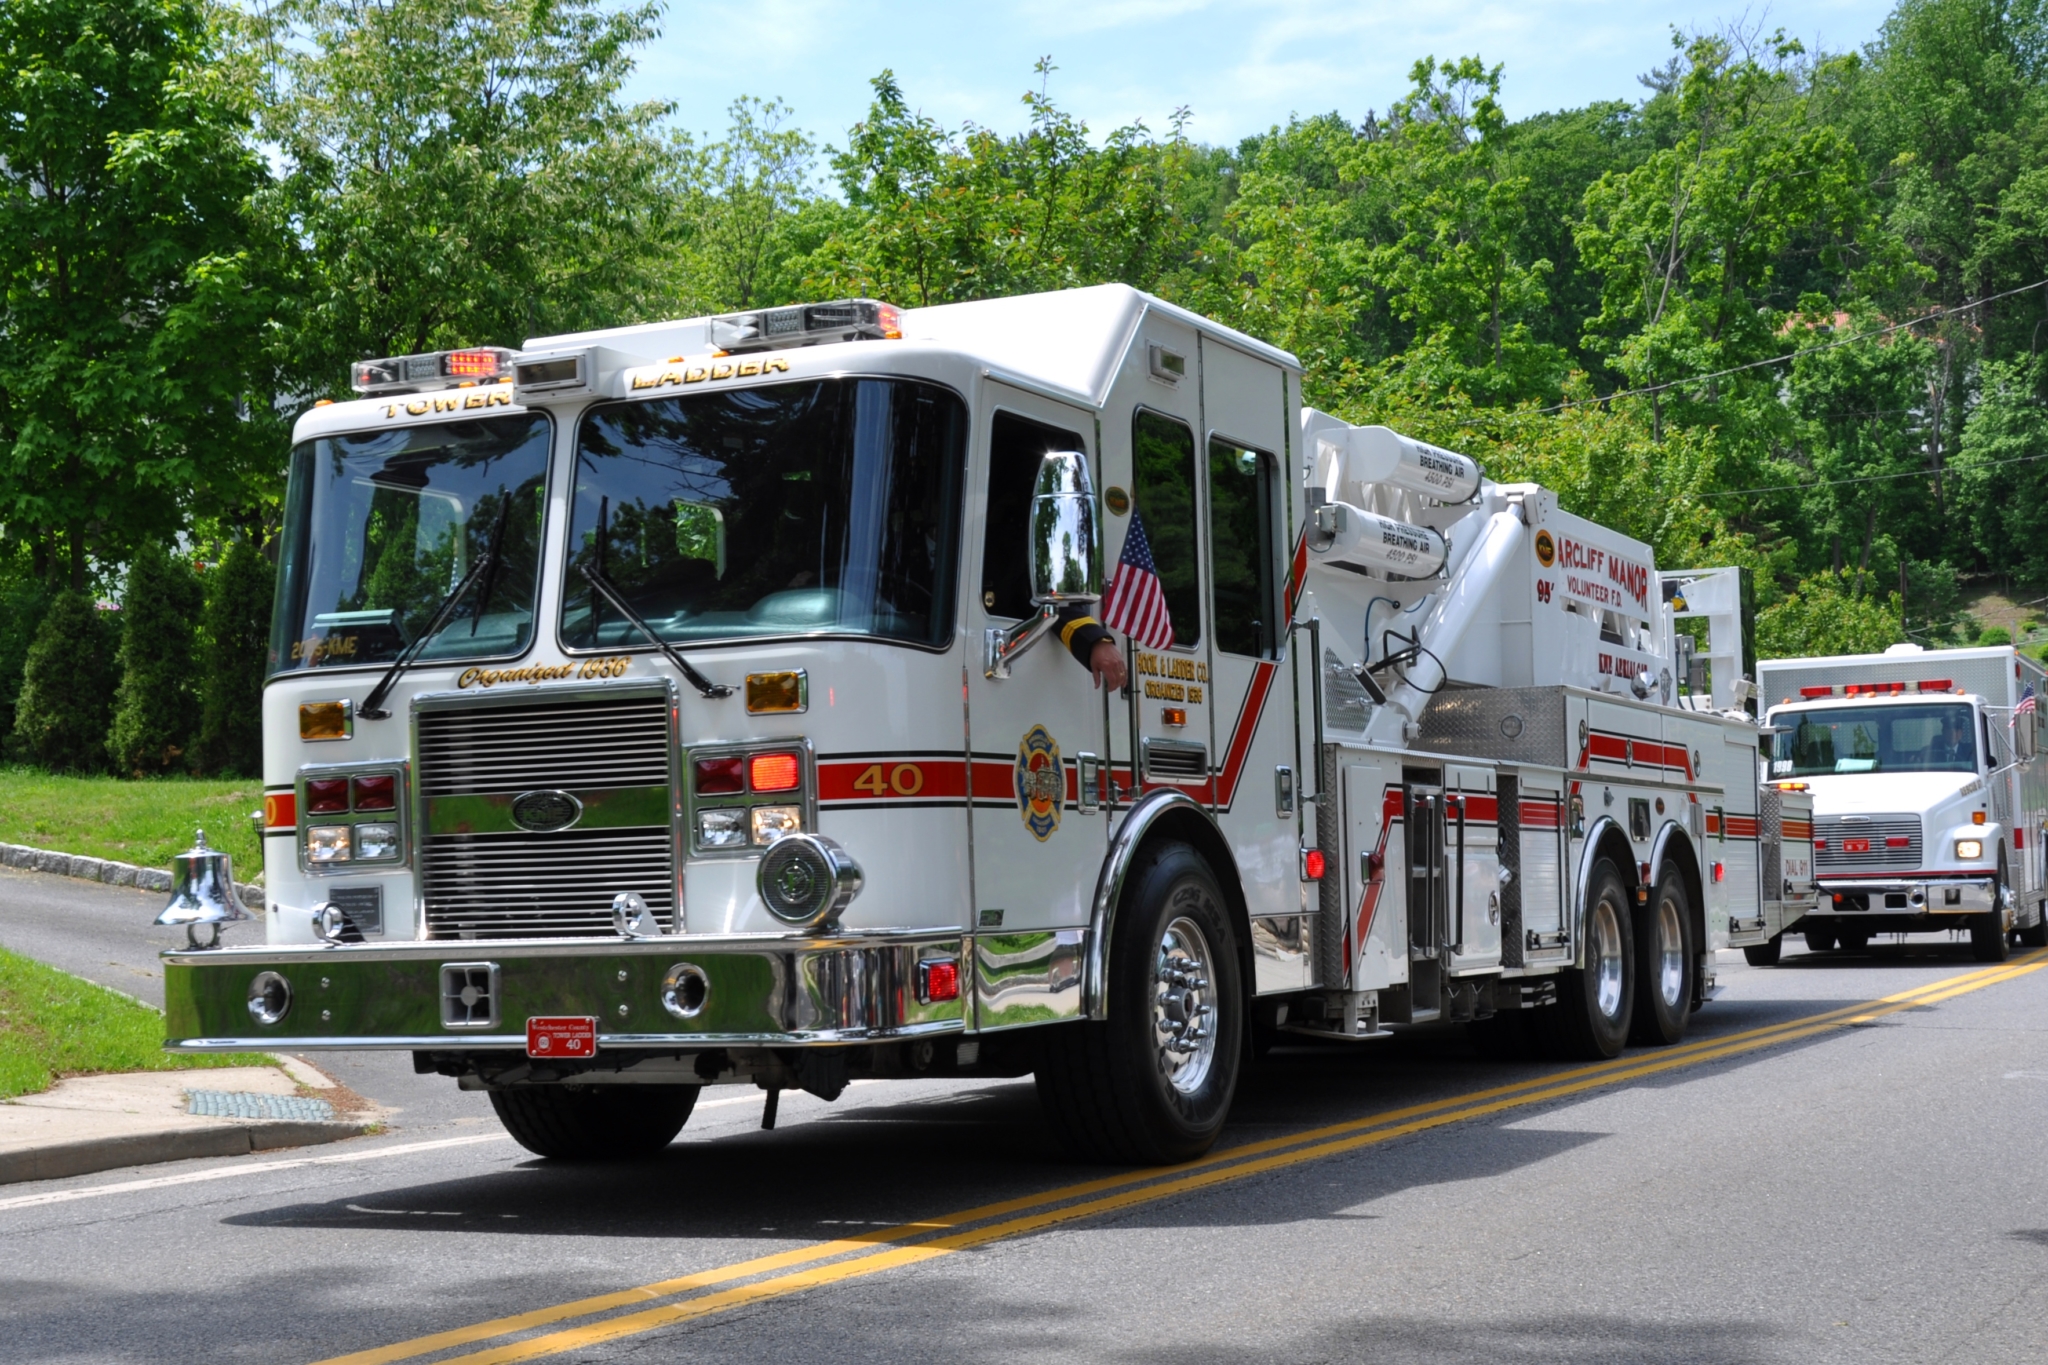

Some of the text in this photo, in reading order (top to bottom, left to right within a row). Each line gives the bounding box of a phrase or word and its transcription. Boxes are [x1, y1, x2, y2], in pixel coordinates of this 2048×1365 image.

[631, 358, 789, 391] LADDER
[378, 391, 511, 419] TOWER
[1420, 455, 1465, 478] BREATHING AIR
[1425, 471, 1455, 489] 4500 PSI
[1383, 532, 1430, 554] BREATHING AIR
[1386, 548, 1418, 565] 4500 PSI
[1567, 575, 1622, 608] VOLUNTEER F.D.
[1608, 555, 1647, 612] MANOR
[458, 655, 632, 689] Organized 1936
[1137, 653, 1158, 677] HOOK
[1160, 656, 1166, 677] &
[1167, 657, 1195, 681] LADDER
[1145, 680, 1185, 702] ORGANIZED
[1773, 760, 1793, 773] 1998
[854, 763, 924, 796] 40
[1785, 859, 1808, 876] DIAL 911
[565, 1038, 581, 1050] 40
